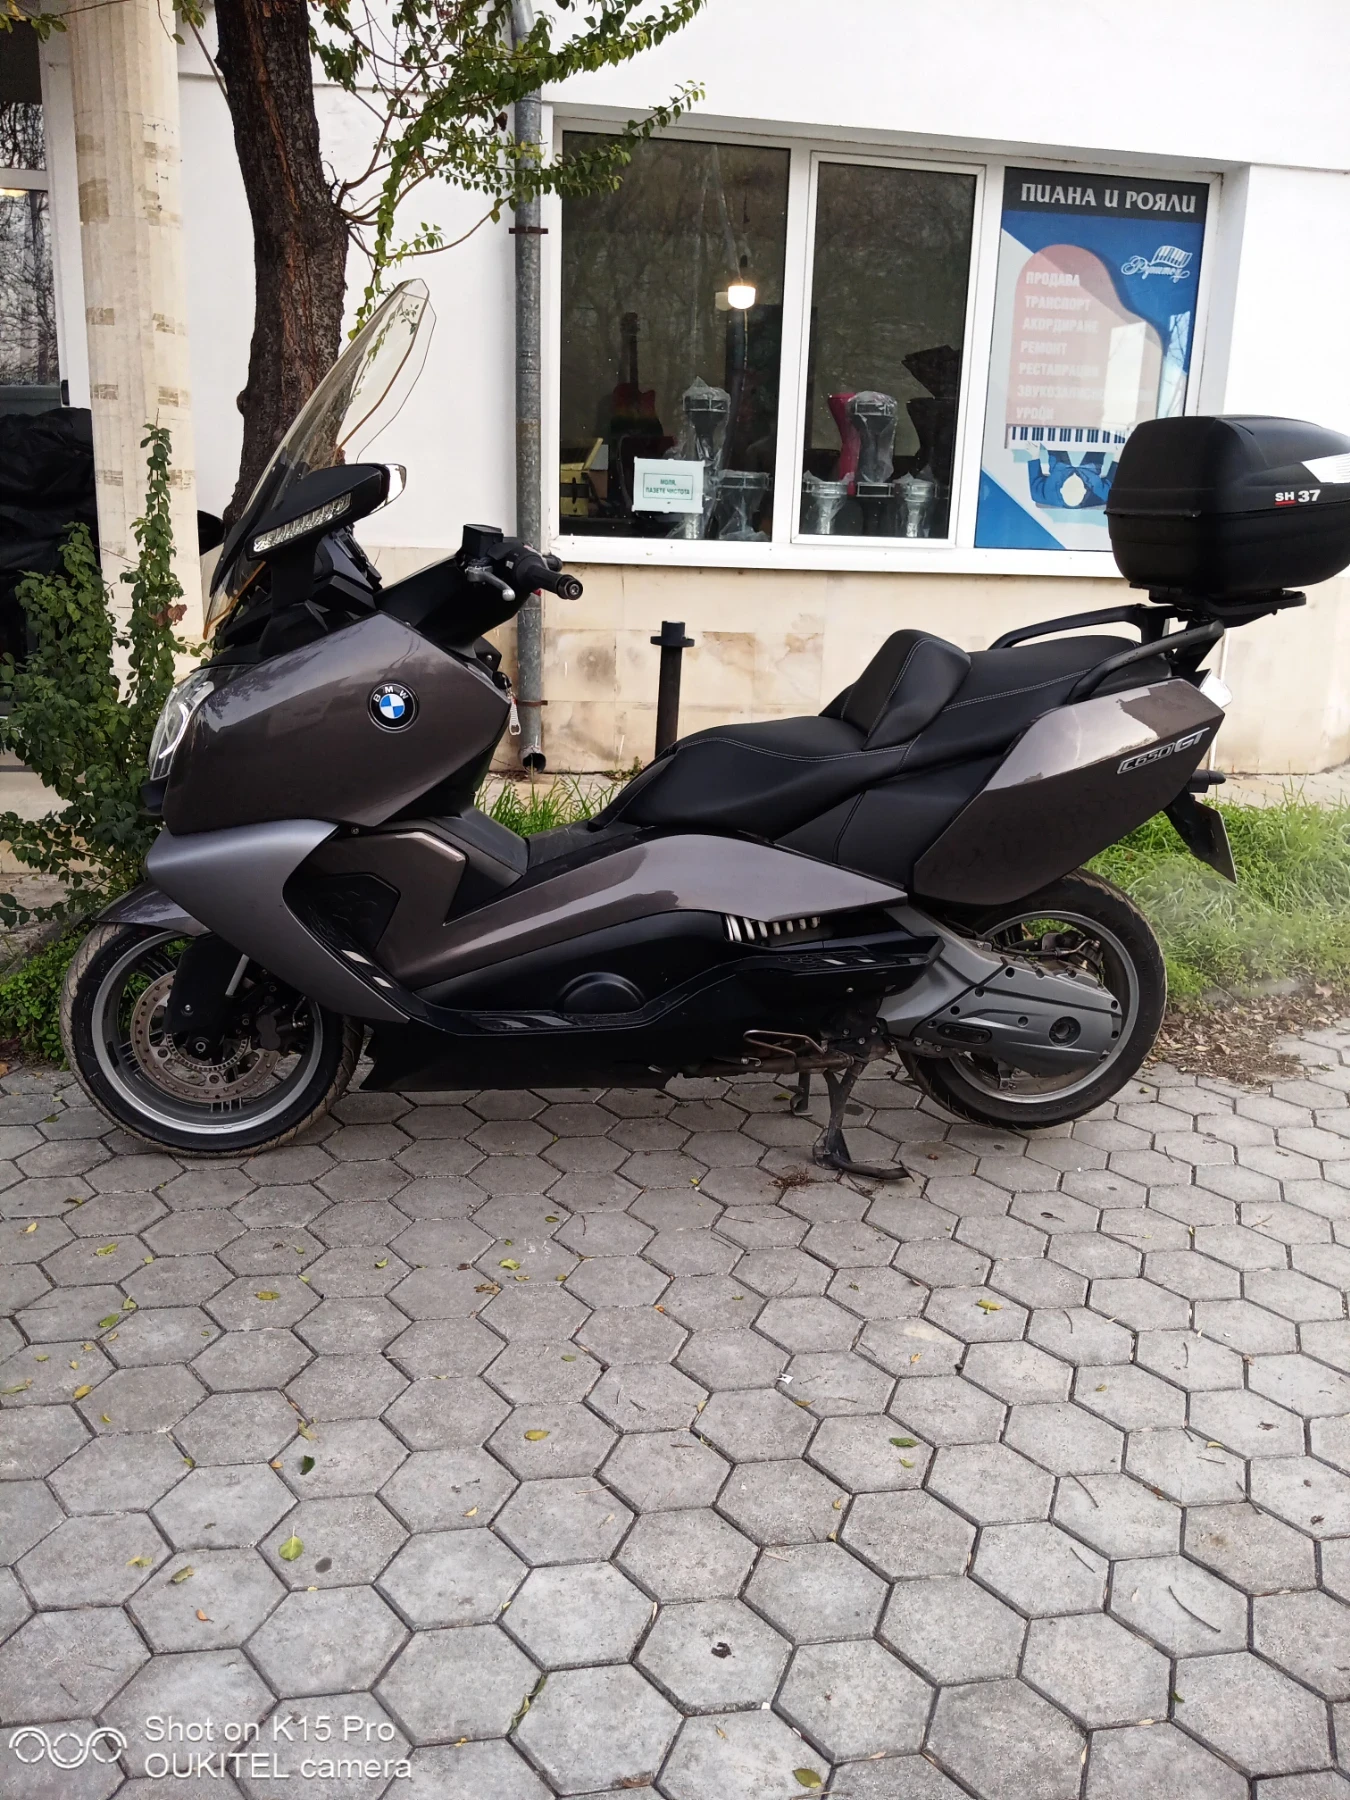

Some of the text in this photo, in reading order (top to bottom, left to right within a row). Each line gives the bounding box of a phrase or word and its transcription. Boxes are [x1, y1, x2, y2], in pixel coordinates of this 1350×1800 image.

[1020, 183, 1197, 213] ПИАНА И РОЯЛИ
[1024, 295, 1091, 311] ТРАНСПОРТ
[1020, 340, 1068, 356] РЕМОНТ
[1275, 489, 1321, 502] SH 37
[373, 686, 409, 702] BMW
